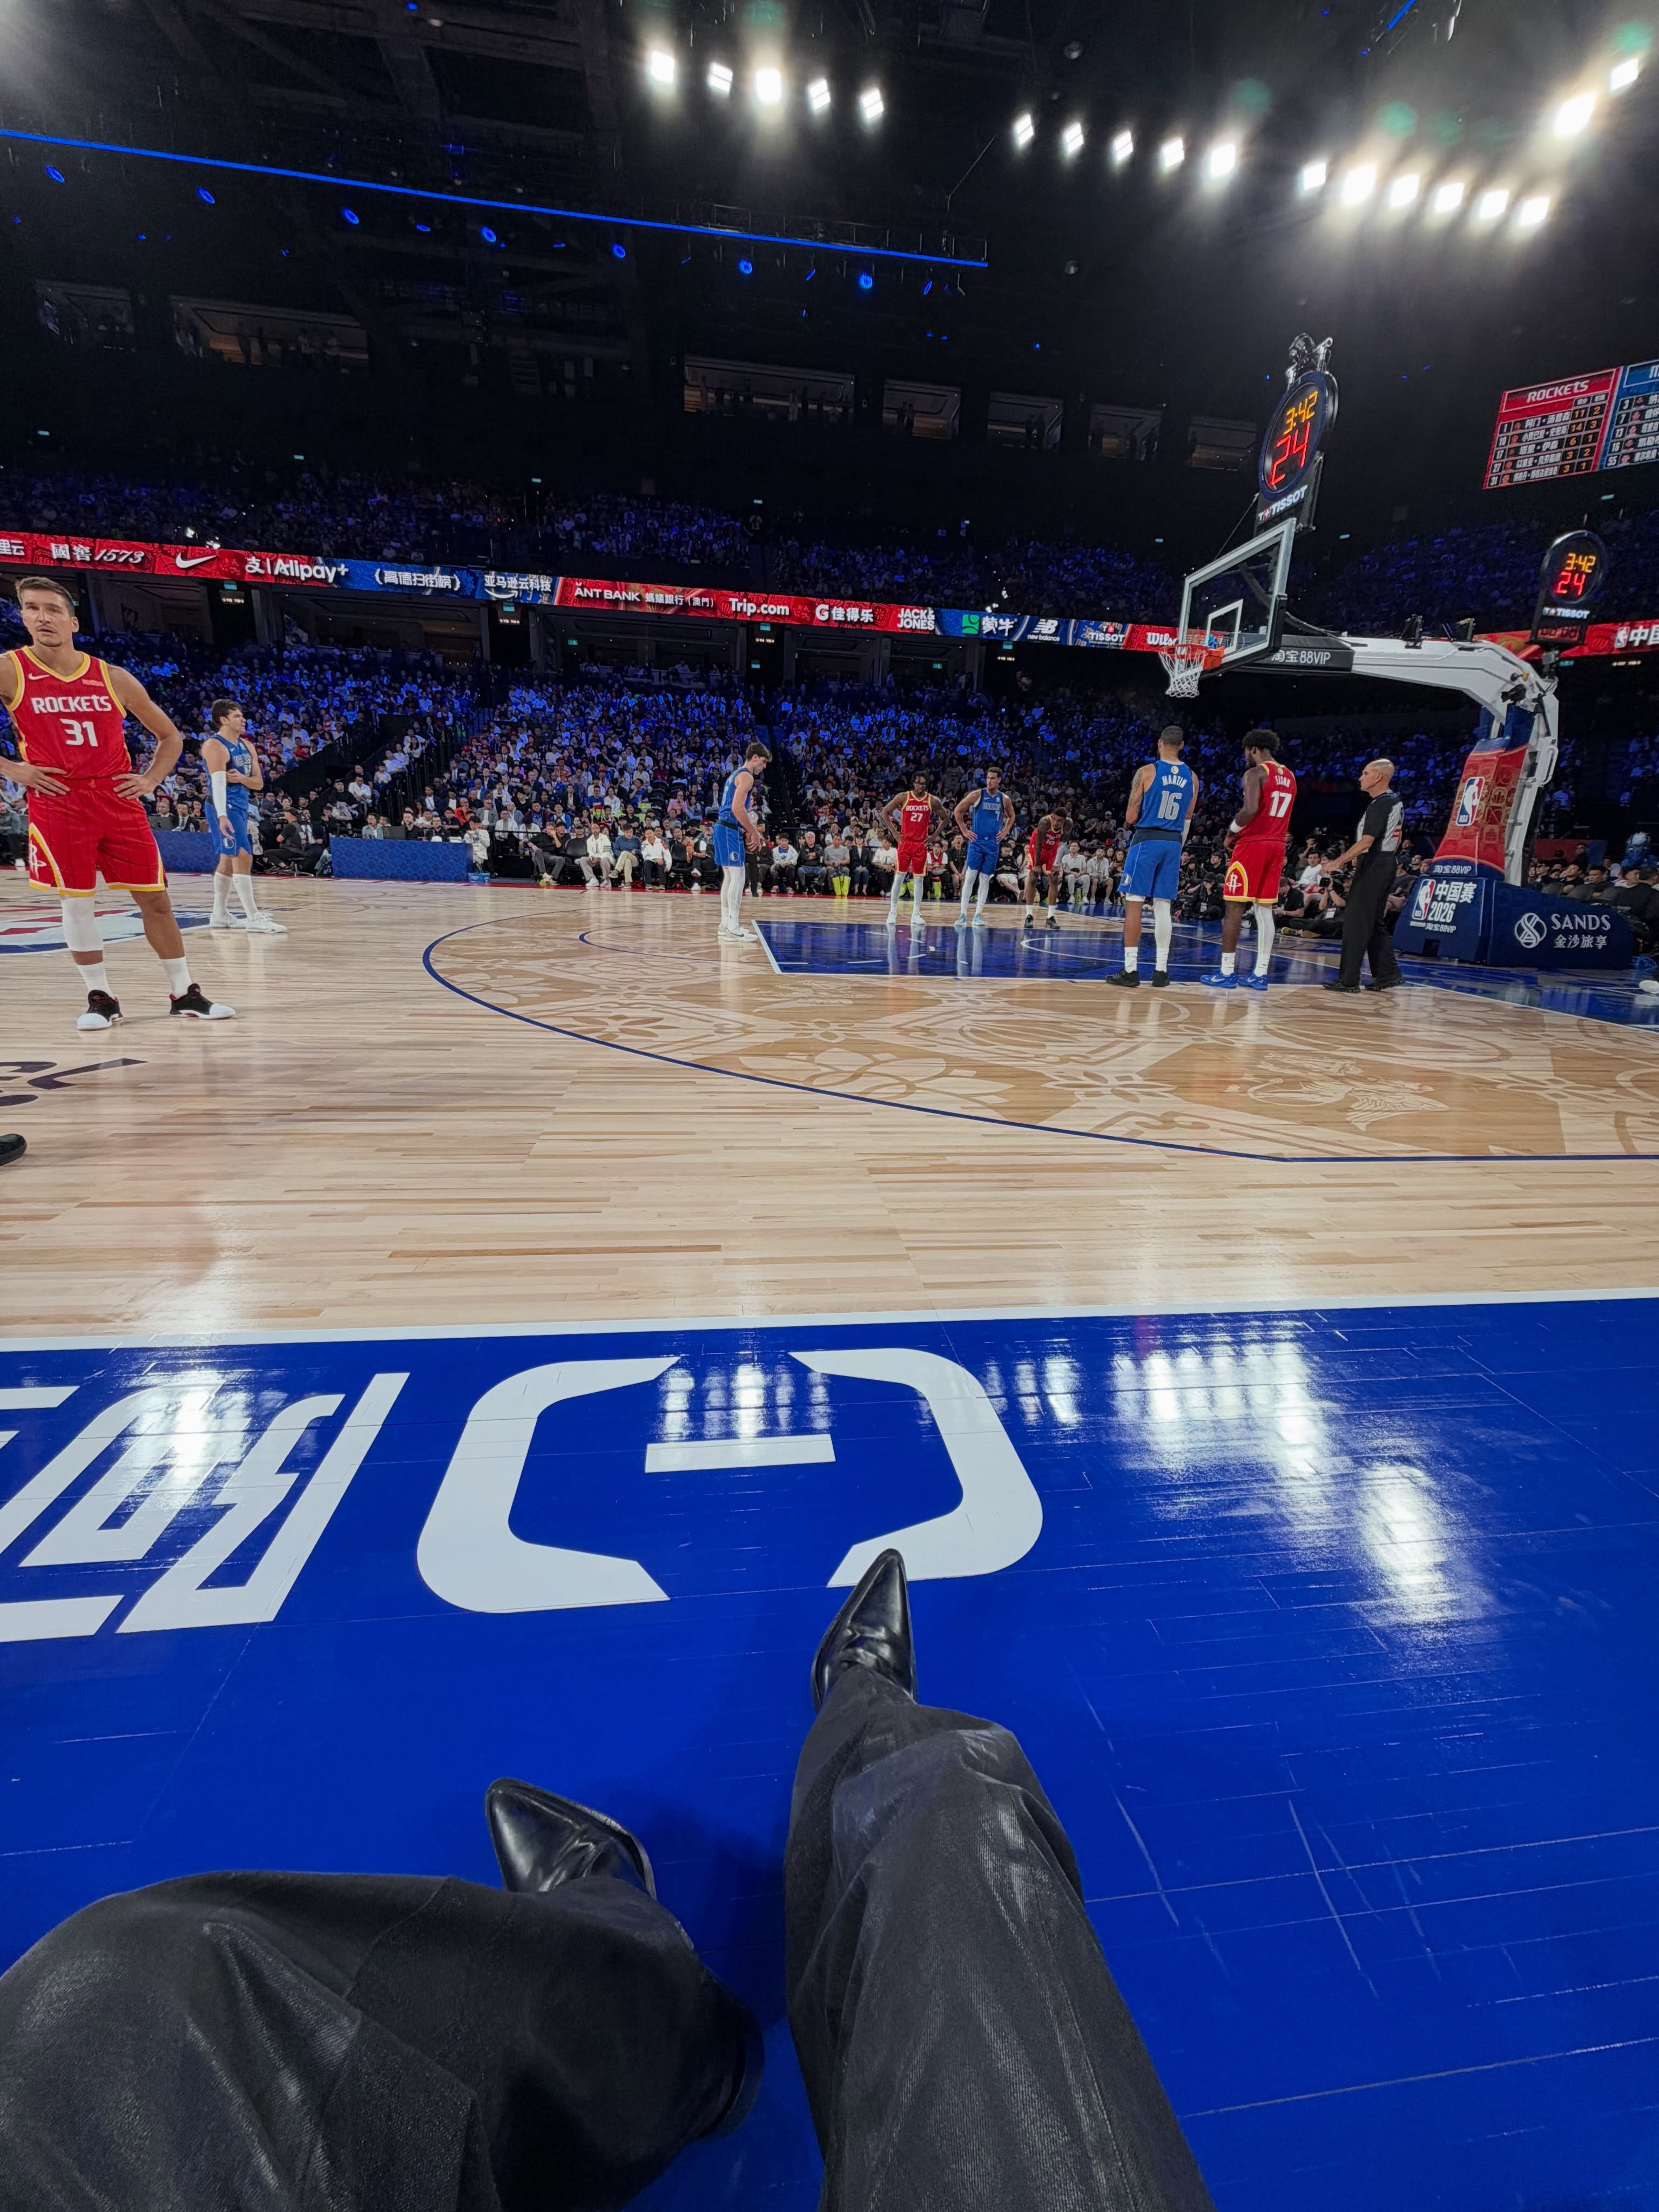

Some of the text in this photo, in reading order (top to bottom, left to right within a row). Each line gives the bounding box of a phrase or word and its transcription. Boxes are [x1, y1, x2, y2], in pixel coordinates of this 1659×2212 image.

[1284, 390, 1318, 435] 3:42
[1503, 423, 1507, 432] 1
[1574, 409, 1584, 418] 11
[1594, 406, 1600, 414] 2
[1499, 436, 1507, 446] 10
[1572, 423, 1582, 432] 14
[1590, 420, 1597, 428] 3
[1271, 421, 1311, 485] 24
[1496, 449, 1504, 459] 17
[1570, 437, 1576, 446] 6
[1588, 434, 1593, 442] 1
[1493, 463, 1501, 473] 27
[1567, 451, 1573, 460] 3
[1584, 449, 1590, 457] 2
[1563, 465, 1570, 473] 3
[1271, 485, 1307, 515] TISSOT
[1565, 552, 1596, 573] 3:42
[485, 574, 552, 592] 亚马逊云科技
[1556, 571, 1586, 596] 24
[604, 589, 640, 602] BANK
[729, 598, 790, 616] Trip.com
[832, 606, 874, 622] 佳得乐
[898, 608, 935, 621] JACK&
[1556, 608, 1590, 619] TISSOT
[897, 618, 935, 631] JONES
[1089, 632, 1125, 642] TISSOT
[1271, 650, 1331, 665] 淘宝88VIP
[31, 694, 112, 714] ROCKETS
[60, 718, 98, 747] 31
[1162, 774, 1188, 788] MARTIN
[1157, 790, 1182, 820] 16
[1270, 791, 1292, 818] 17
[911, 812, 923, 822] 27
[995, 811, 1000, 821] 7
[1433, 865, 1472, 874] 淘宝88VIP
[1435, 880, 1477, 903] 中国赛
[1427, 901, 1456, 923] 2026
[1550, 913, 1611, 931] SANDS
[1554, 934, 1608, 949] 金沙旅享
